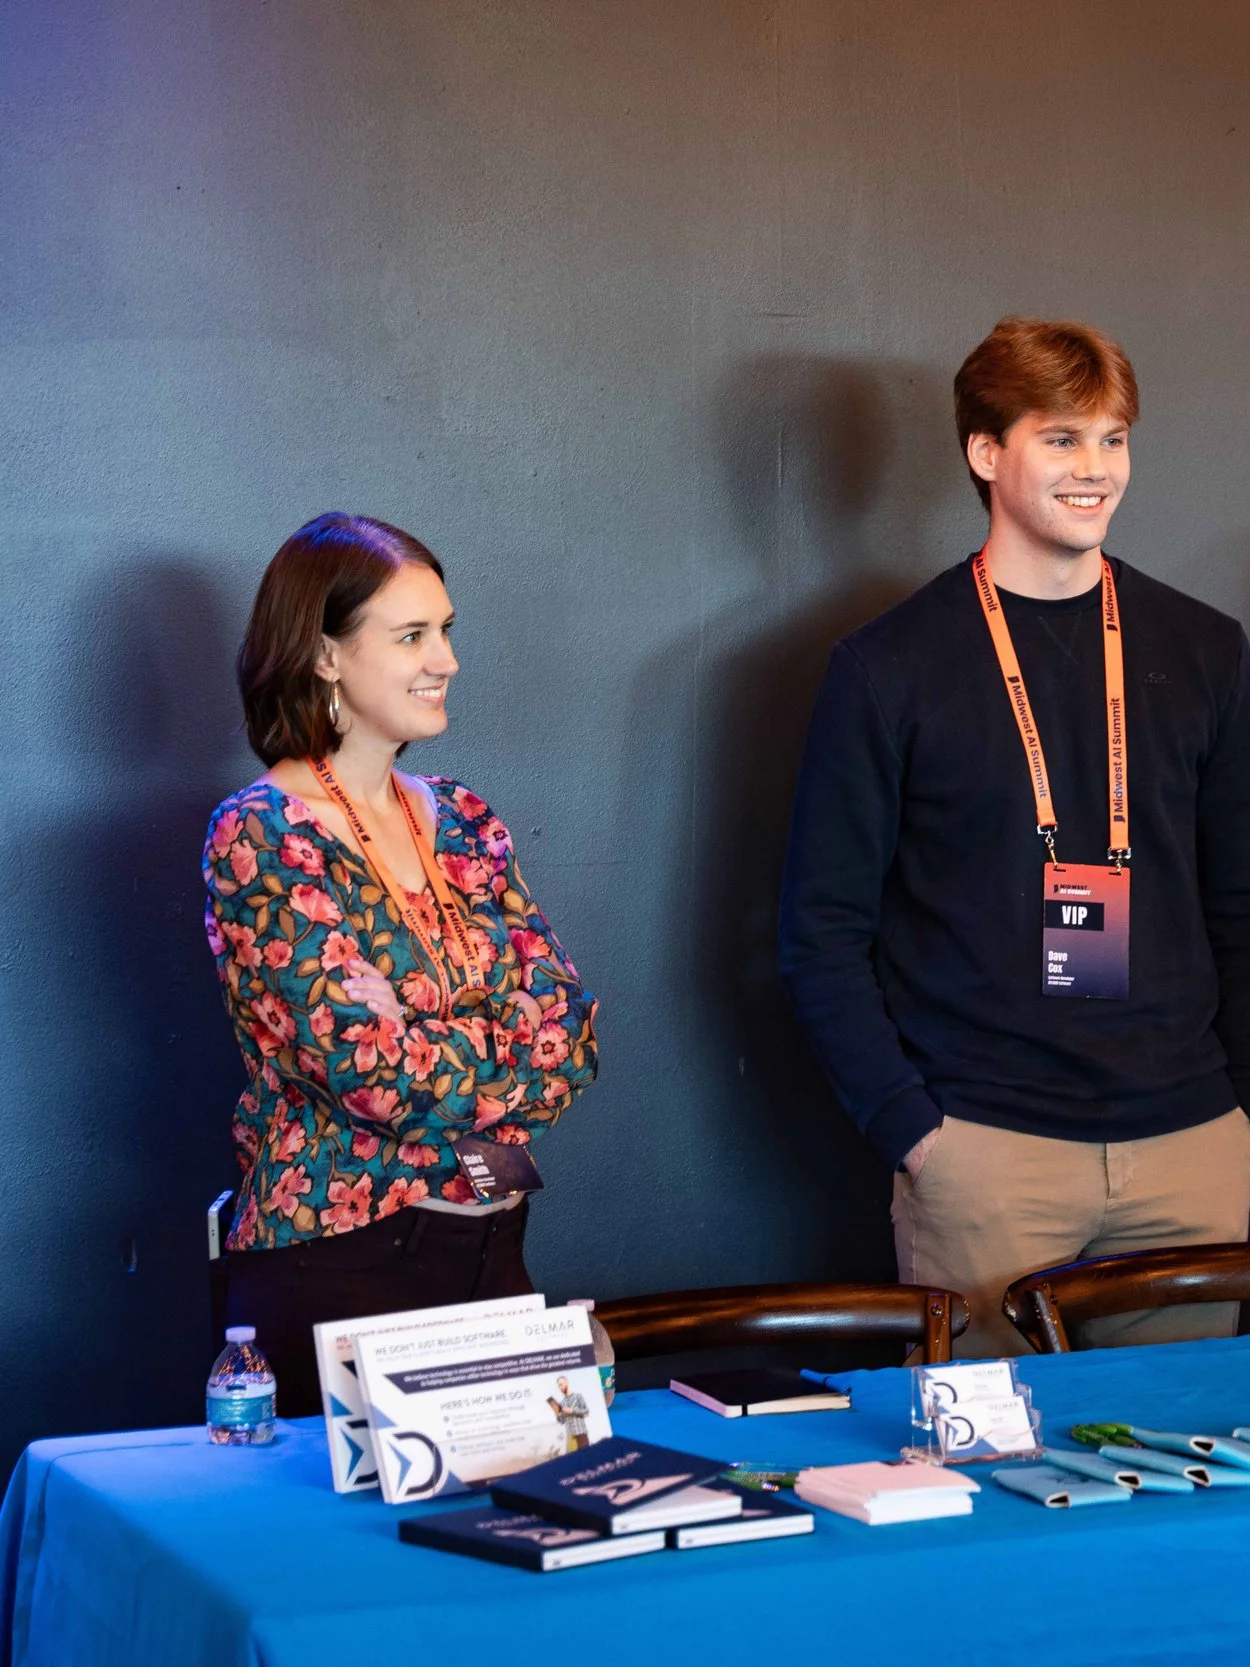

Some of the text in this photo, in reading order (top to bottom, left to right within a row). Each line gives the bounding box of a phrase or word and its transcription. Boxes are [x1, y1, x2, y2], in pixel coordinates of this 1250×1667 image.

[977, 568, 998, 612] Summit
[1105, 575, 1115, 622] Midwest
[1012, 685, 1047, 798] Midwest AI Summit
[1110, 698, 1123, 813] Midwest AI Summit
[321, 771, 335, 783] AI
[331, 784, 365, 834] Midwest
[1062, 905, 1088, 925] VIP
[448, 911, 475, 961] Midwest
[469, 965, 479, 977] AI
[1048, 951, 1068, 961] Dave
[1048, 963, 1063, 973] Cox
[463, 1154, 484, 1165] Claire
[468, 1165, 489, 1176] Smith
[524, 1320, 575, 1336] DELMAR
[374, 1346, 386, 1356] WE
[388, 1341, 415, 1354] DON'T
[417, 1338, 435, 1350] JUST
[437, 1334, 461, 1346] BUILD
[471, 1394, 492, 1405] HOW
[495, 1392, 508, 1401] WE
[508, 1390, 522, 1399] DO
